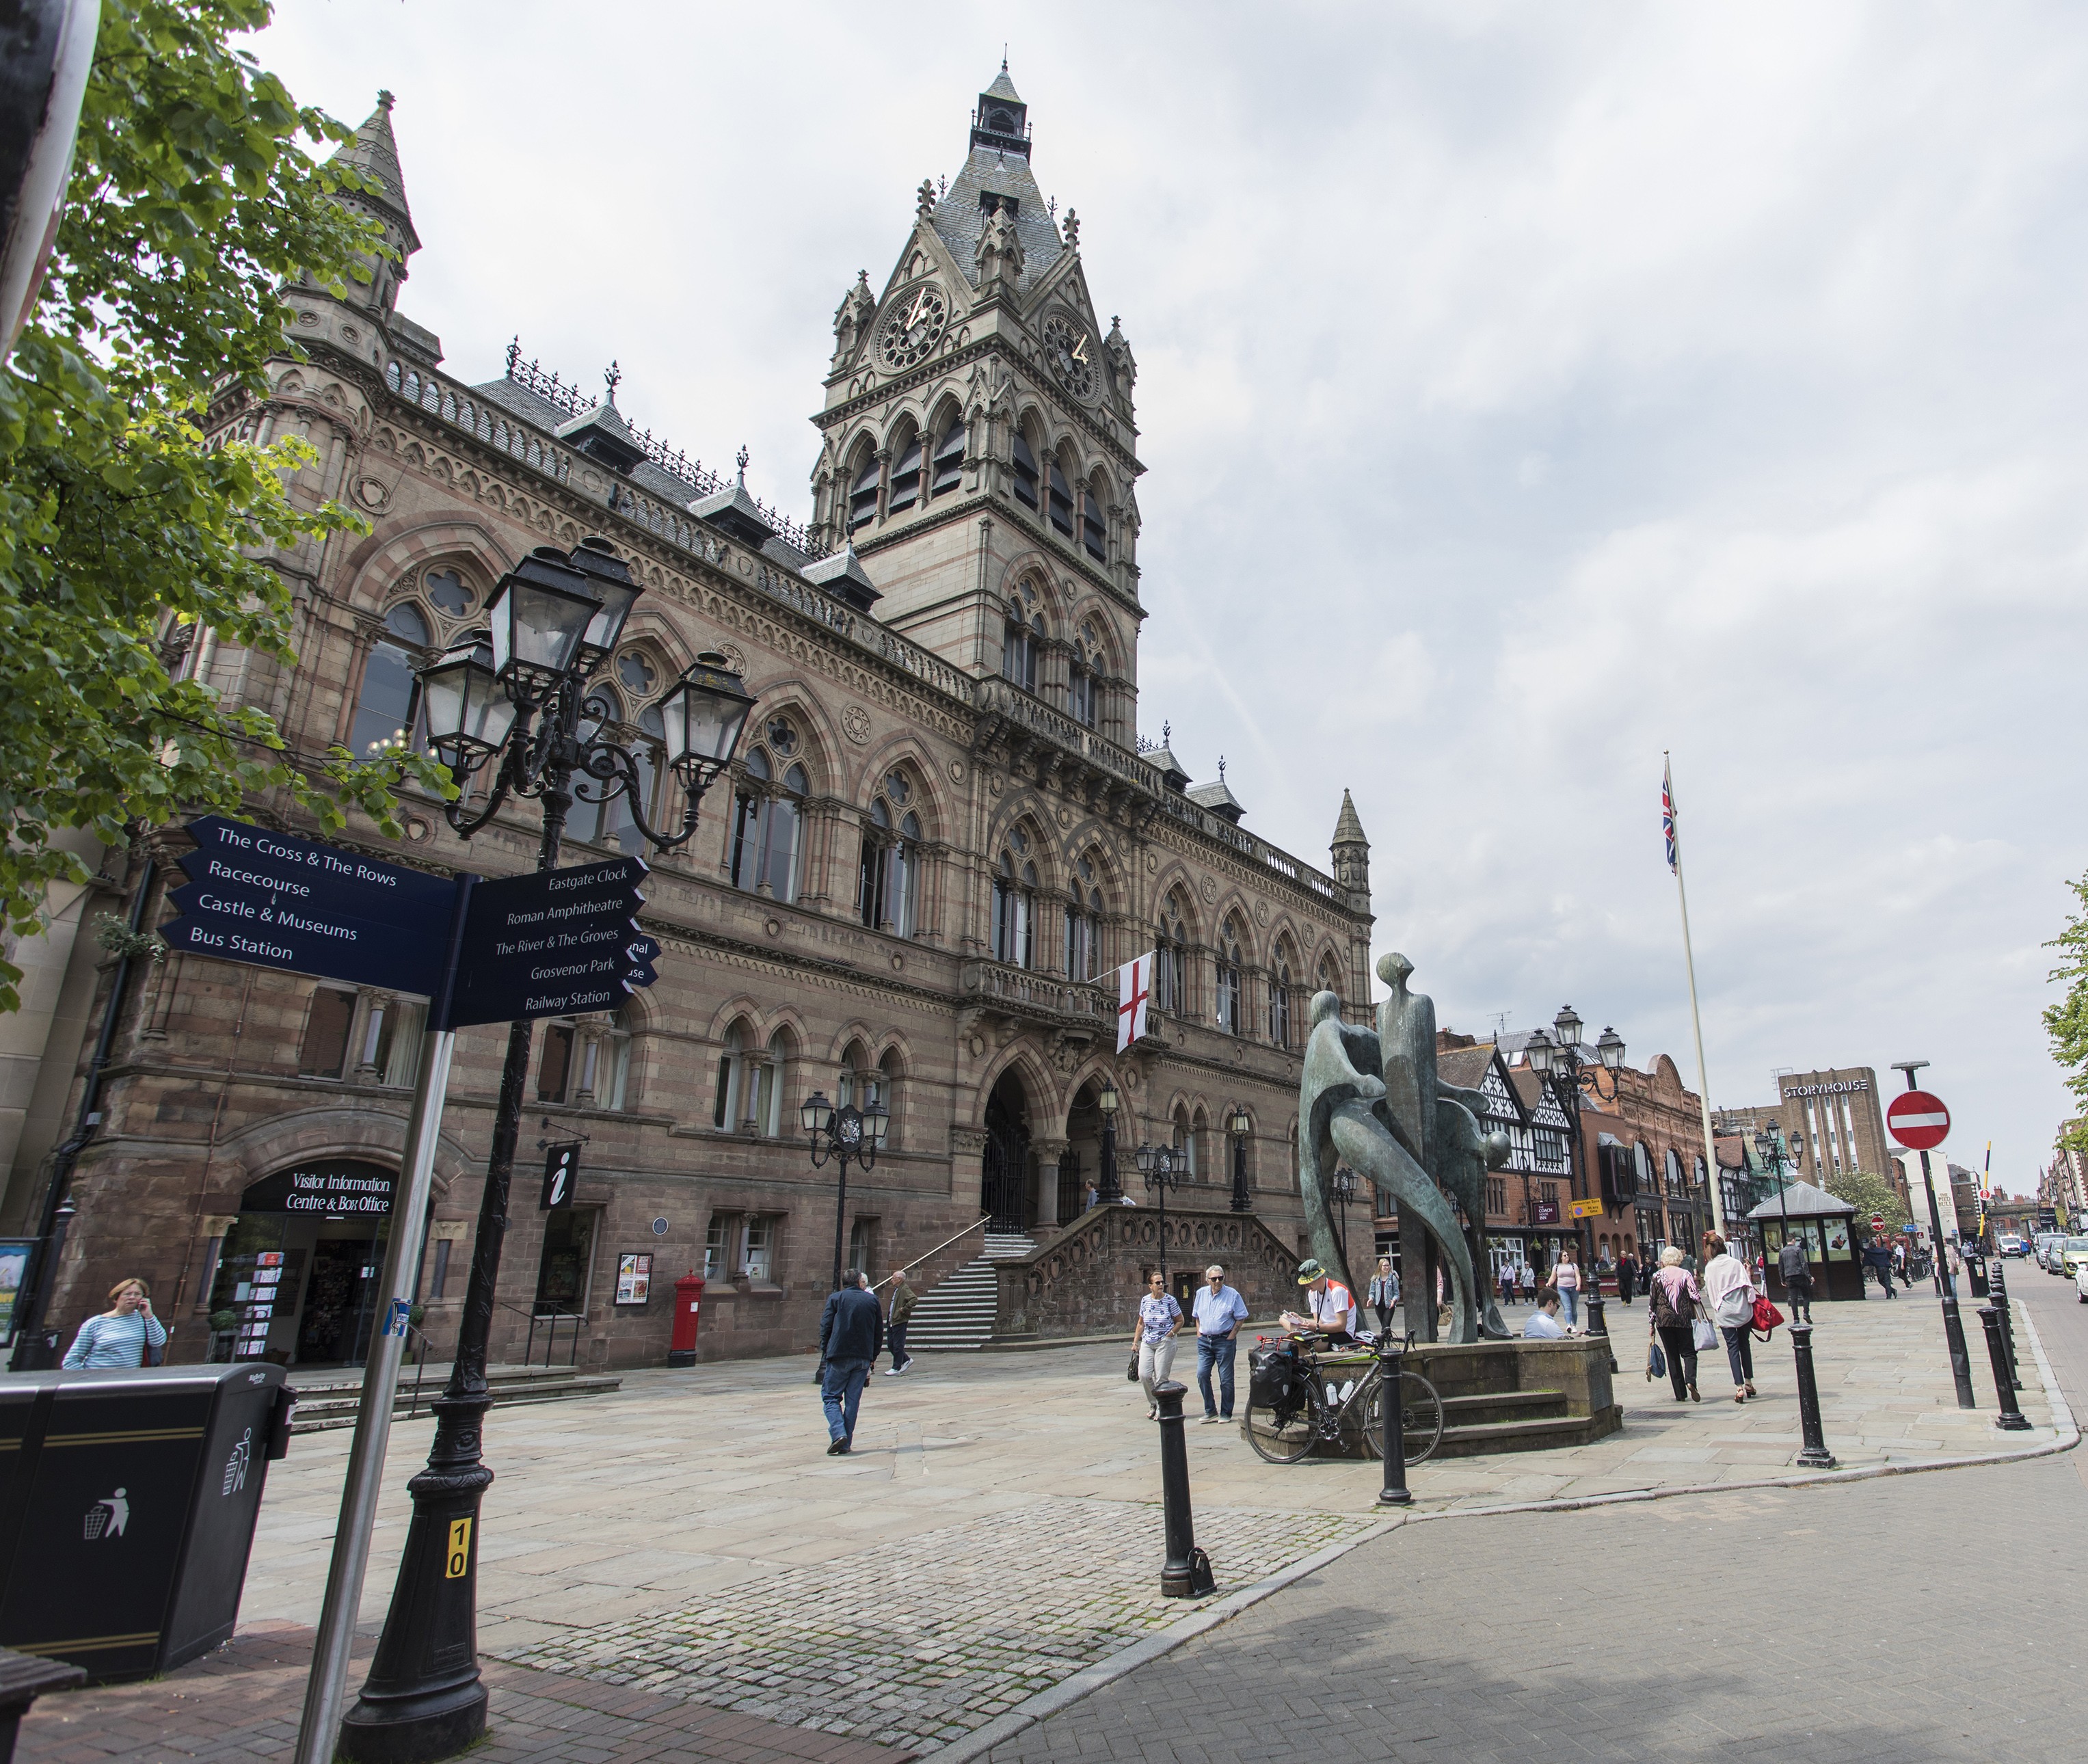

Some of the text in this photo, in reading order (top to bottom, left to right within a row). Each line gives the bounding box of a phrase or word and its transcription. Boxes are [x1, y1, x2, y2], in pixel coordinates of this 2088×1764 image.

[219, 827, 397, 887] The Cross & The Rows
[209, 860, 310, 897] Racecourse
[548, 866, 628, 891] Eastgate Clock
[199, 894, 358, 941] Castle & Museums
[507, 899, 623, 925] Roman Amphitheatre
[191, 927, 293, 960] Bus Station
[496, 929, 619, 955] The River & The Groves
[531, 957, 615, 980] Grosvenor Park
[525, 990, 611, 1011] Railway Station
[1784, 1080, 1868, 1097] STORYHOUSE
[293, 1173, 391, 1192] Visitor Information
[286, 1194, 389, 1212] Centre & Box Office
[1342, 1371, 1370, 1409] BOARDMAN
